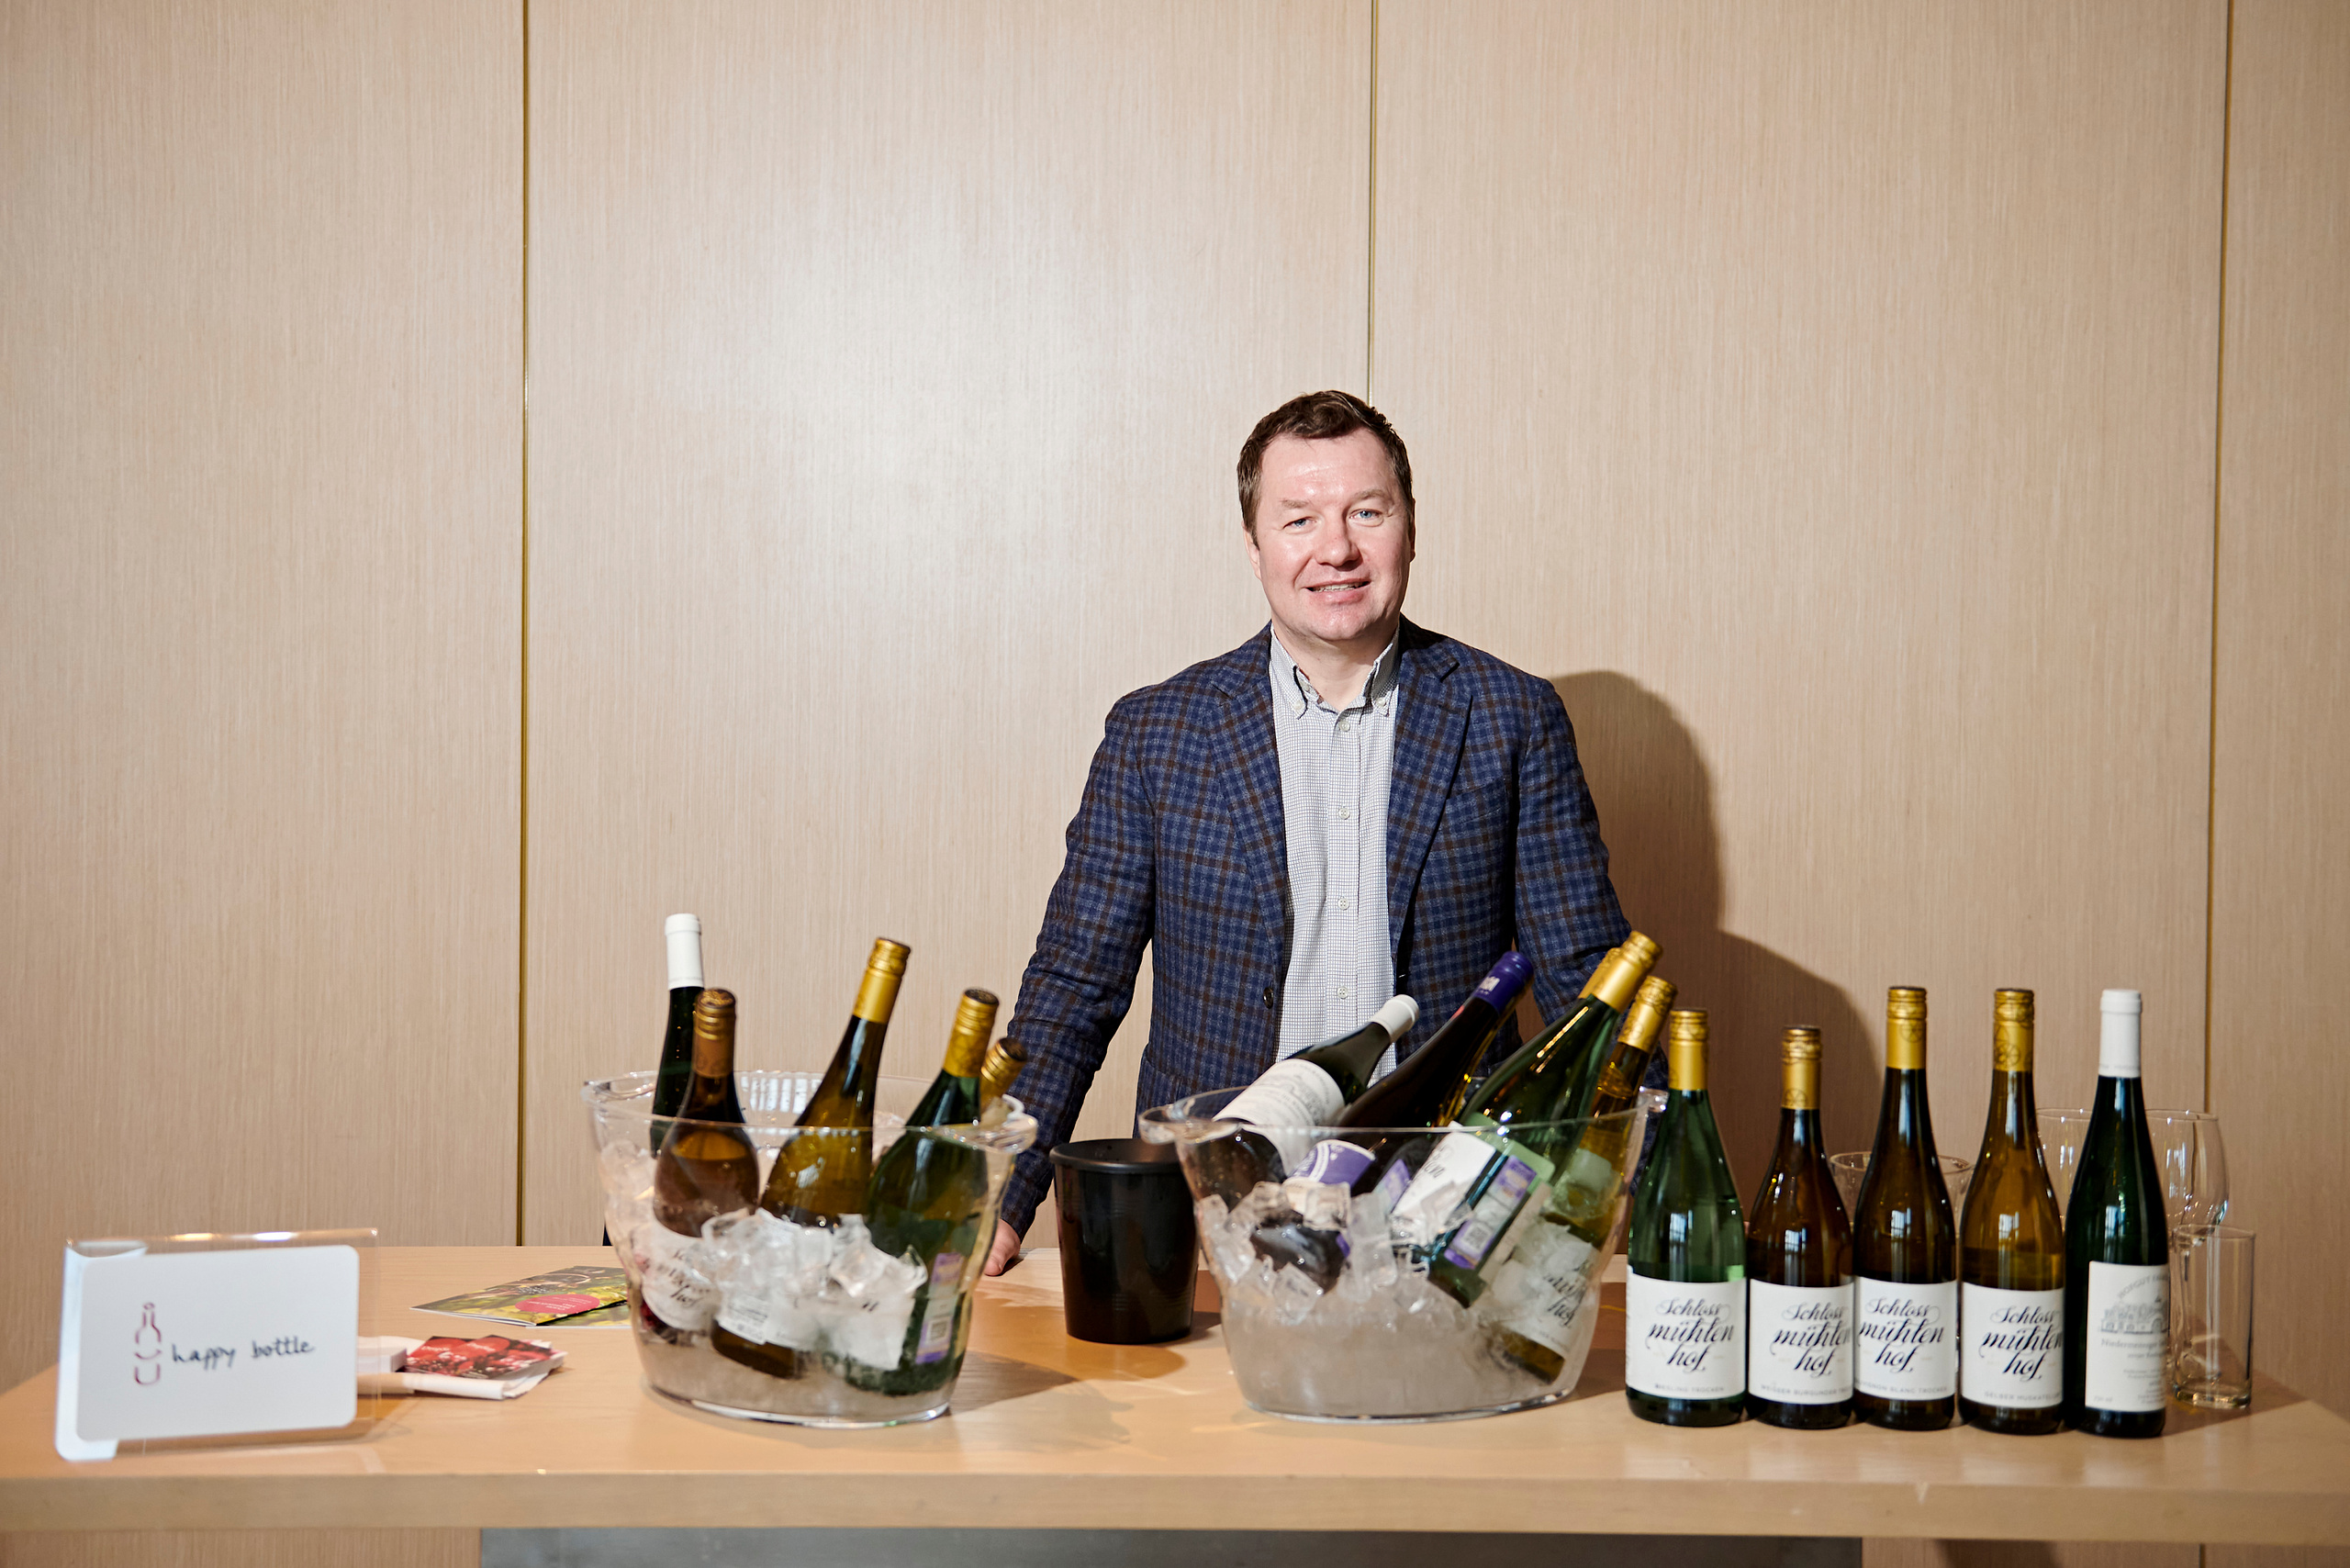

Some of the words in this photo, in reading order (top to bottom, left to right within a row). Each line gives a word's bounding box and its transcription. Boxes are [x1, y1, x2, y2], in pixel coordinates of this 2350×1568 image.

[1656, 1297, 1729, 1318] Schloss
[1782, 1302, 1848, 1321] Schloss
[1865, 1297, 1940, 1318] Schloss
[1990, 1305, 2060, 1324] Schloss
[172, 1343, 236, 1370] happy
[252, 1336, 315, 1359] bottle
[1667, 1342, 1713, 1373] hof
[1794, 1347, 1836, 1378] hof
[1874, 1342, 1923, 1373] hof
[2002, 1350, 2047, 1382] hof
